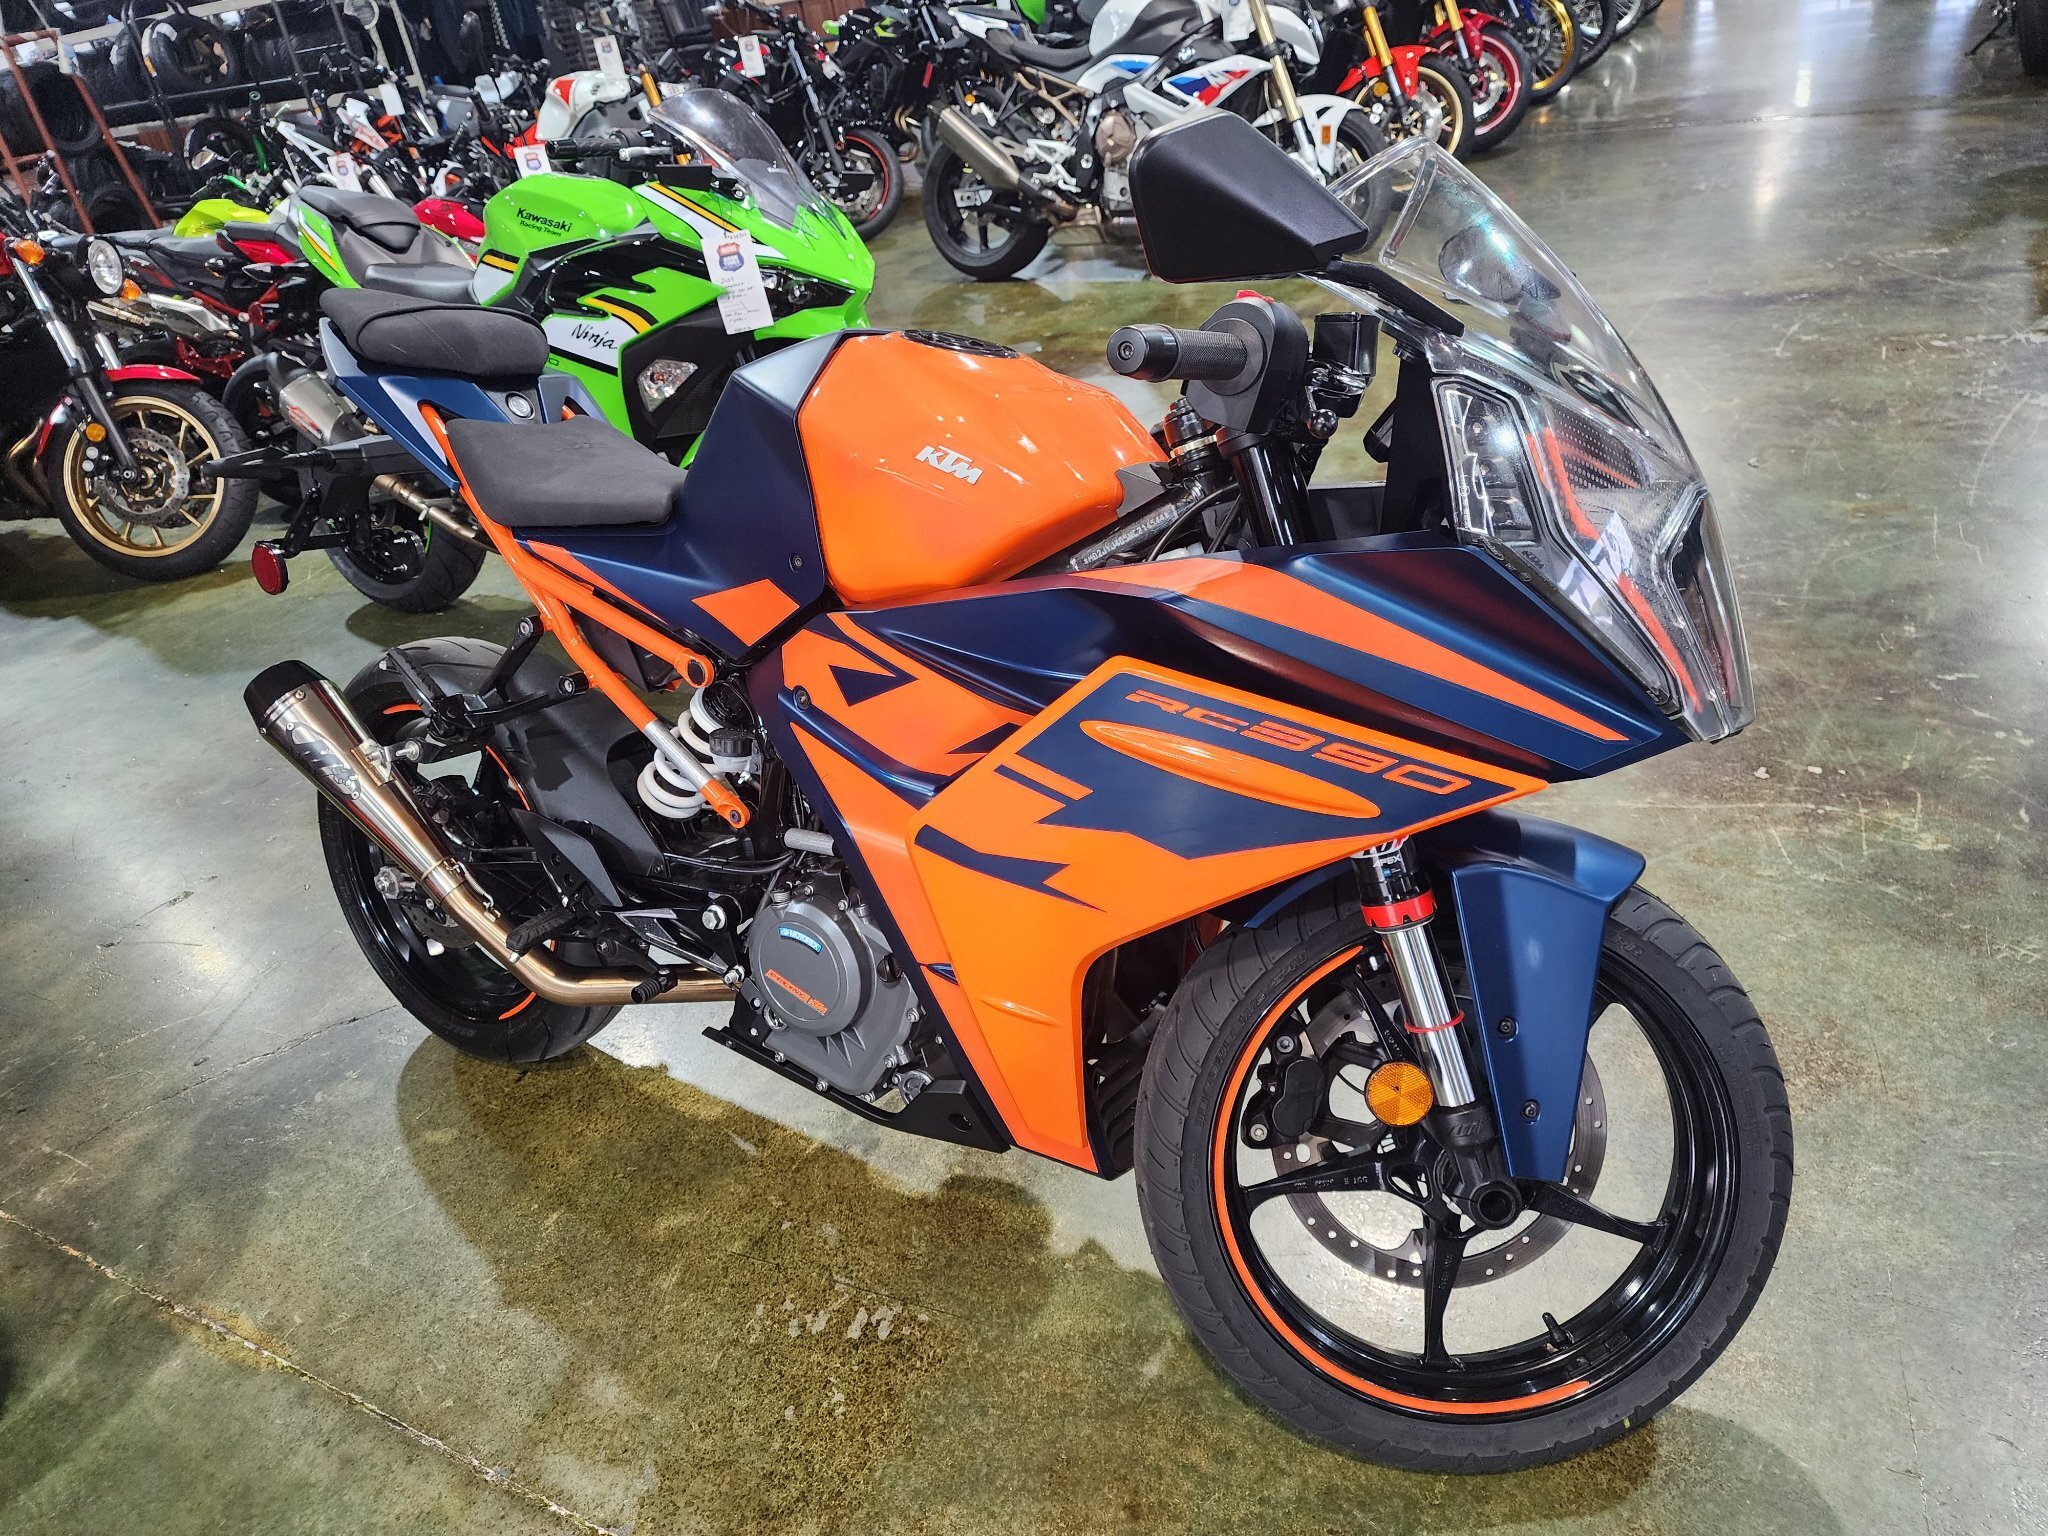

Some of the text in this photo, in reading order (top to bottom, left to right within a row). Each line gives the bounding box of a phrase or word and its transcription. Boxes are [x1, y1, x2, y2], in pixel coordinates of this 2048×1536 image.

[516, 207, 573, 233] Kawasaki
[520, 220, 562, 237] Racing Team
[571, 323, 618, 350] Ninja
[913, 444, 984, 486] KTM
[1372, 853, 1402, 868] APEX
